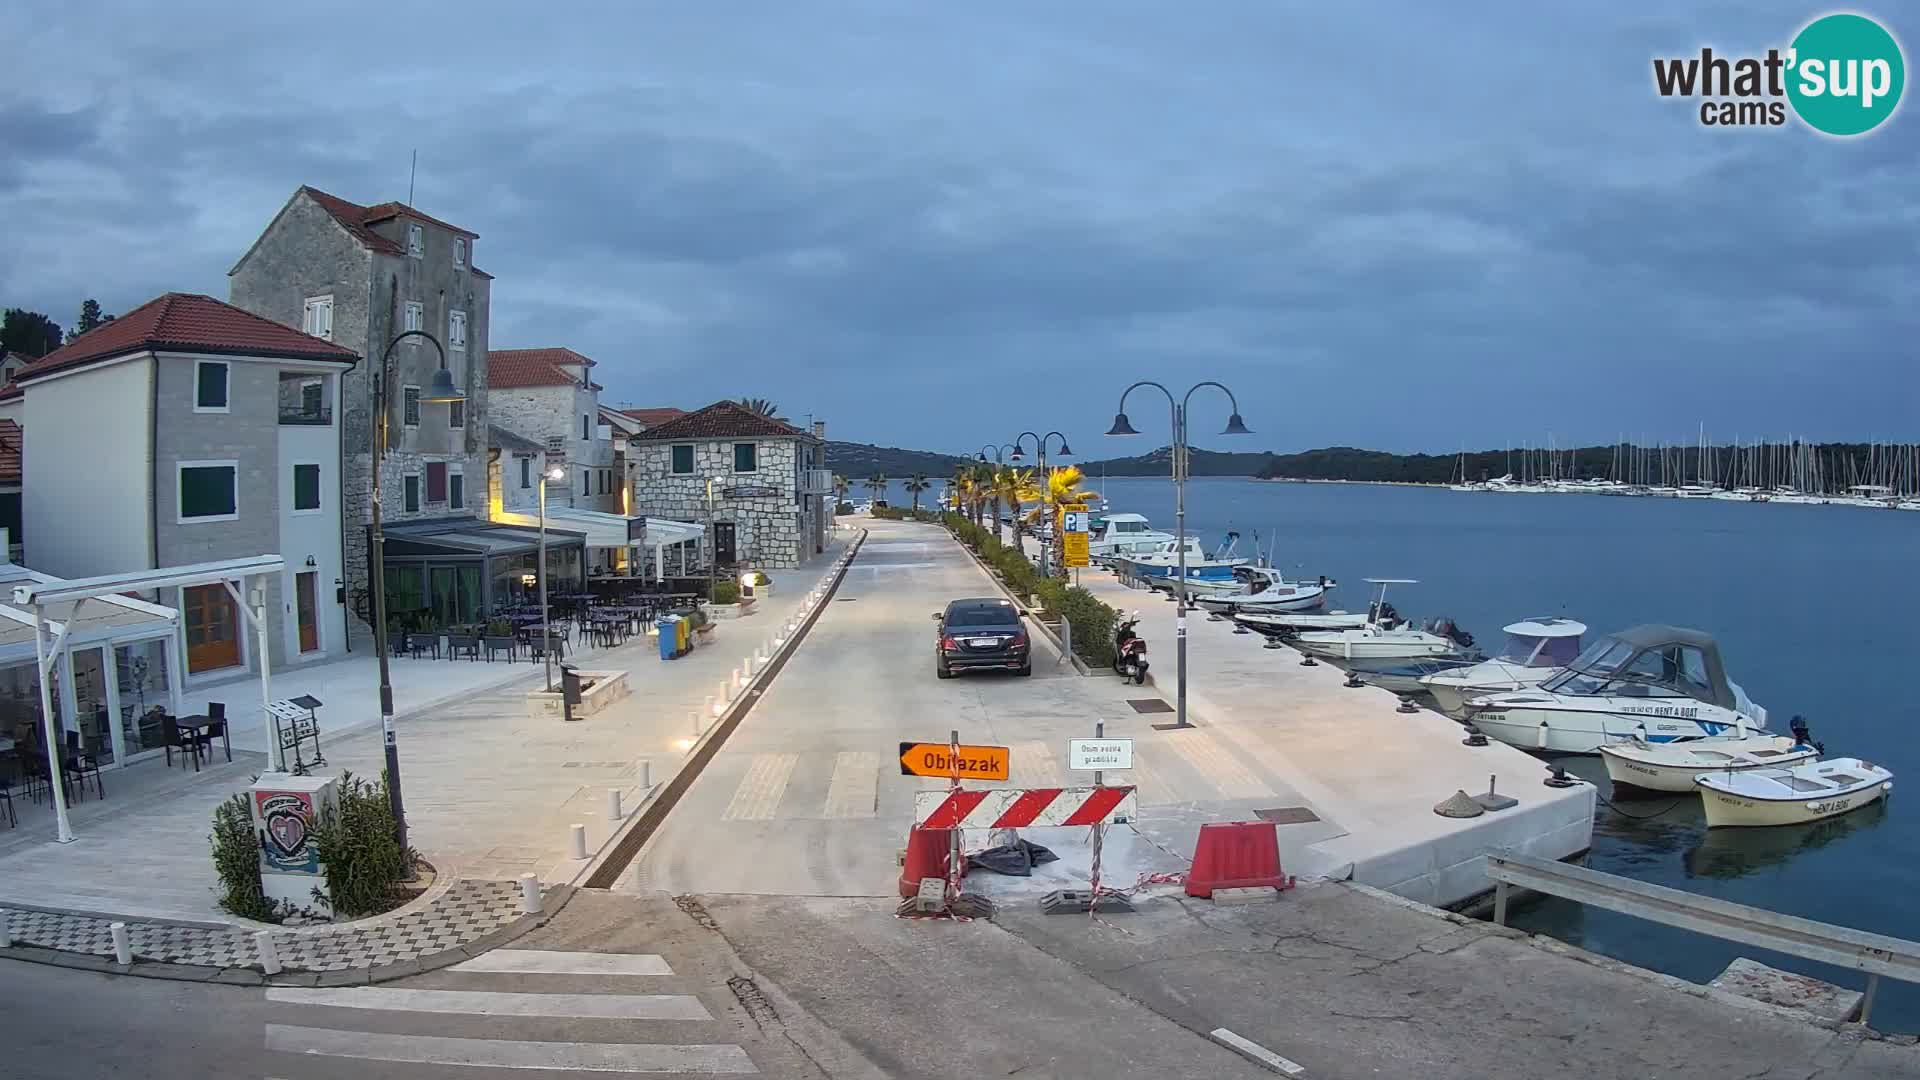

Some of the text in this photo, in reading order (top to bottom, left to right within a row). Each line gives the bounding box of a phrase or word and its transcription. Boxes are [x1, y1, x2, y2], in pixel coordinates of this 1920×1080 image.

[1654, 706, 1673, 716] RENT
[1674, 707, 1679, 716] A
[1680, 707, 1698, 718] BOAT
